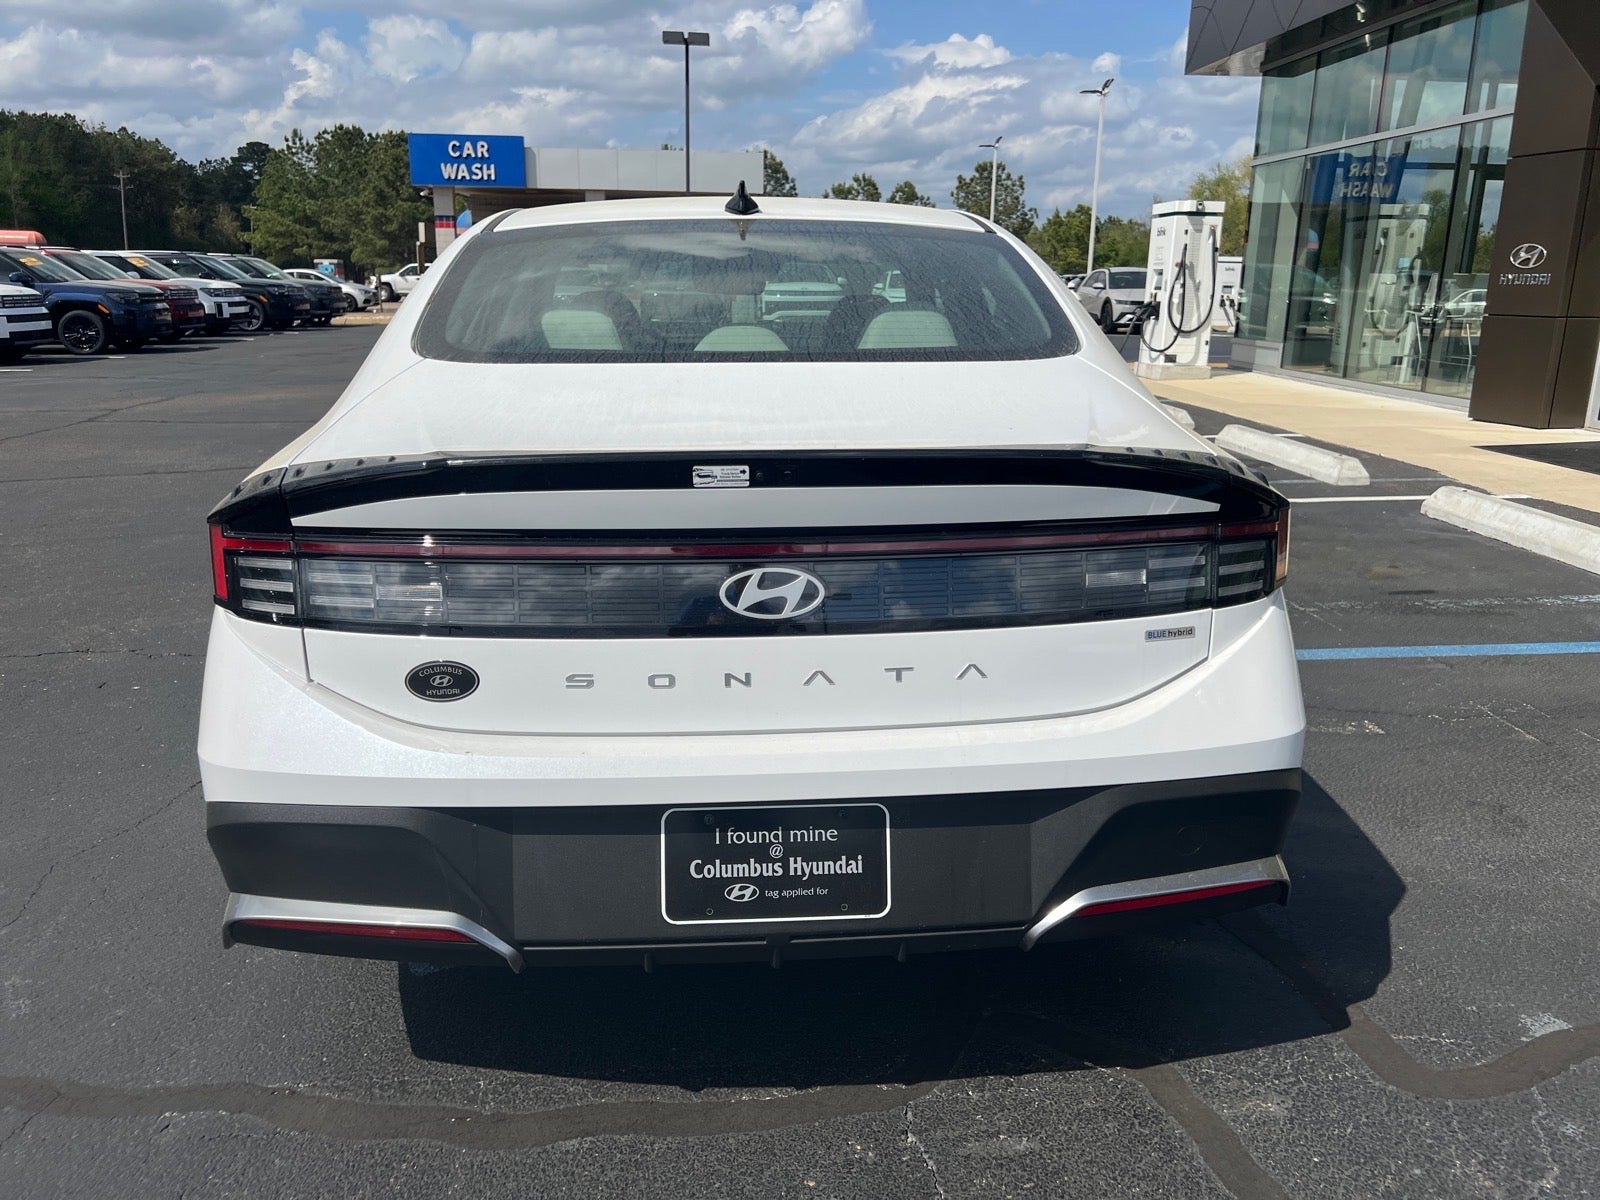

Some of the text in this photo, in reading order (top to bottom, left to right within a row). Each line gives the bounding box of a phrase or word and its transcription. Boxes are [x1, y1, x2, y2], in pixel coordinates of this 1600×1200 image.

[448, 140, 490, 158] CAR
[440, 163, 497, 181] WASH
[1499, 273, 1551, 285] HYUNDAI
[418, 666, 462, 677] COLUMBUS
[565, 662, 989, 690] SONATA
[426, 688, 460, 696] HYUNDAI
[715, 826, 838, 845] I found mine
[769, 843, 783, 859] @
[689, 854, 863, 881] Columbus Hyundai
[765, 886, 828, 899] tag applied for
